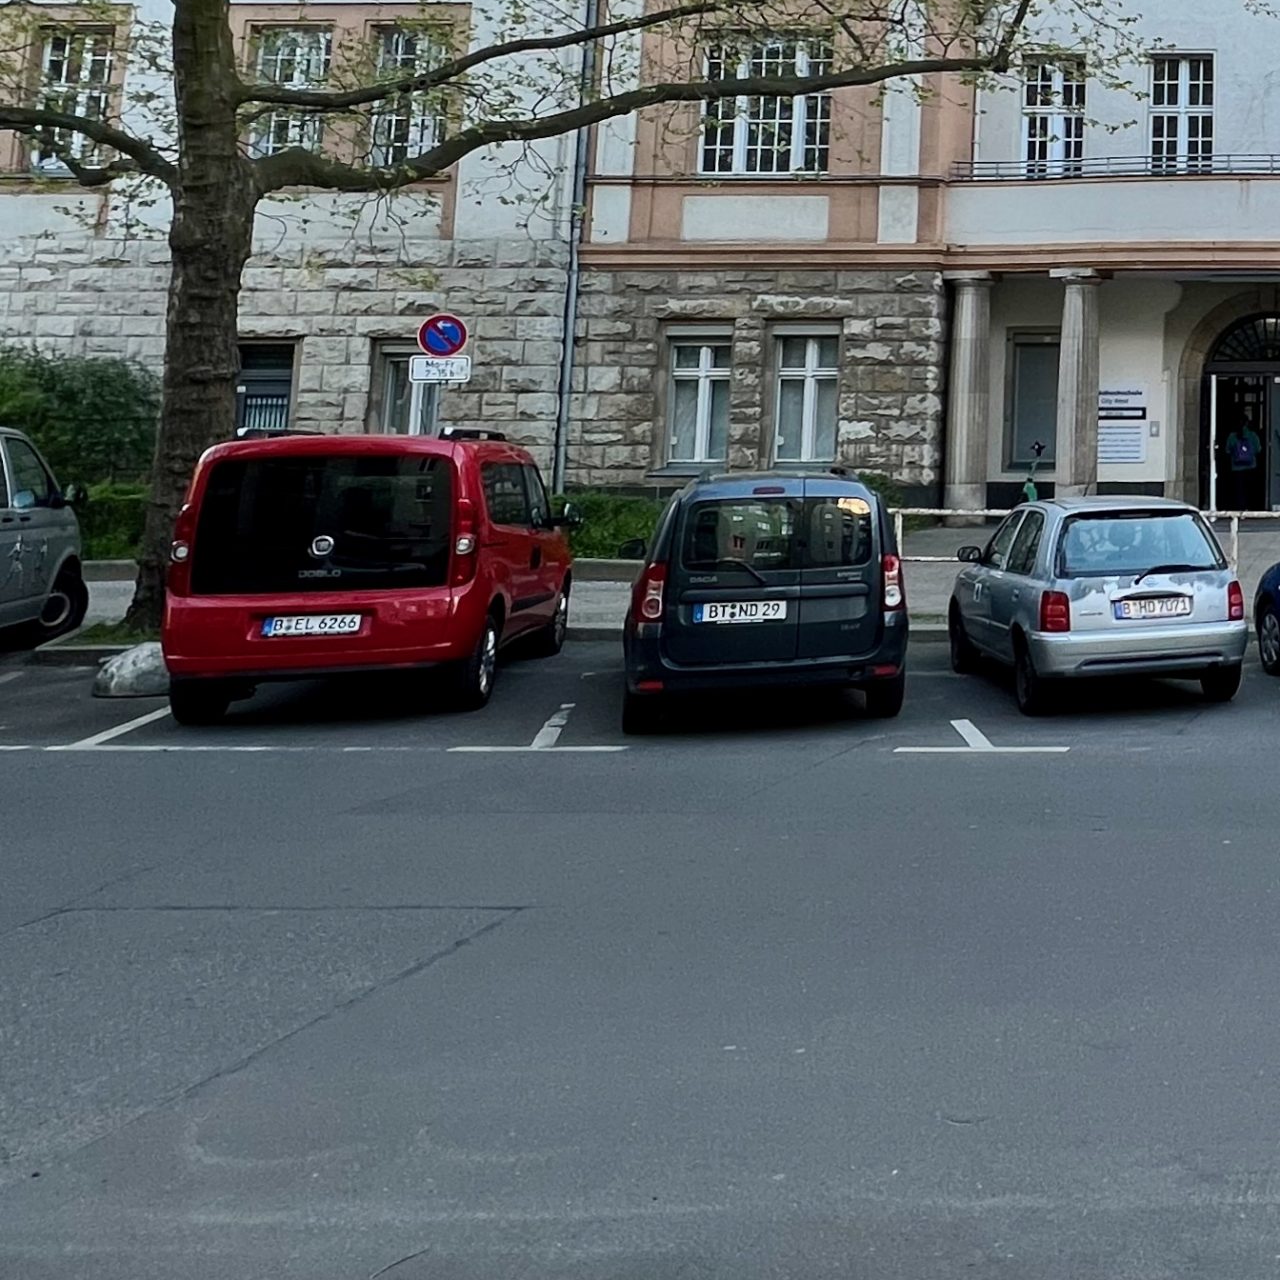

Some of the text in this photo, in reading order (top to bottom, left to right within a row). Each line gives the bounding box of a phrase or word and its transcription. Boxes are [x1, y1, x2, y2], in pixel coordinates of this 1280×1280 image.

[708, 602, 780, 618] BT ND 29
[273, 616, 357, 631] B EL 6266
